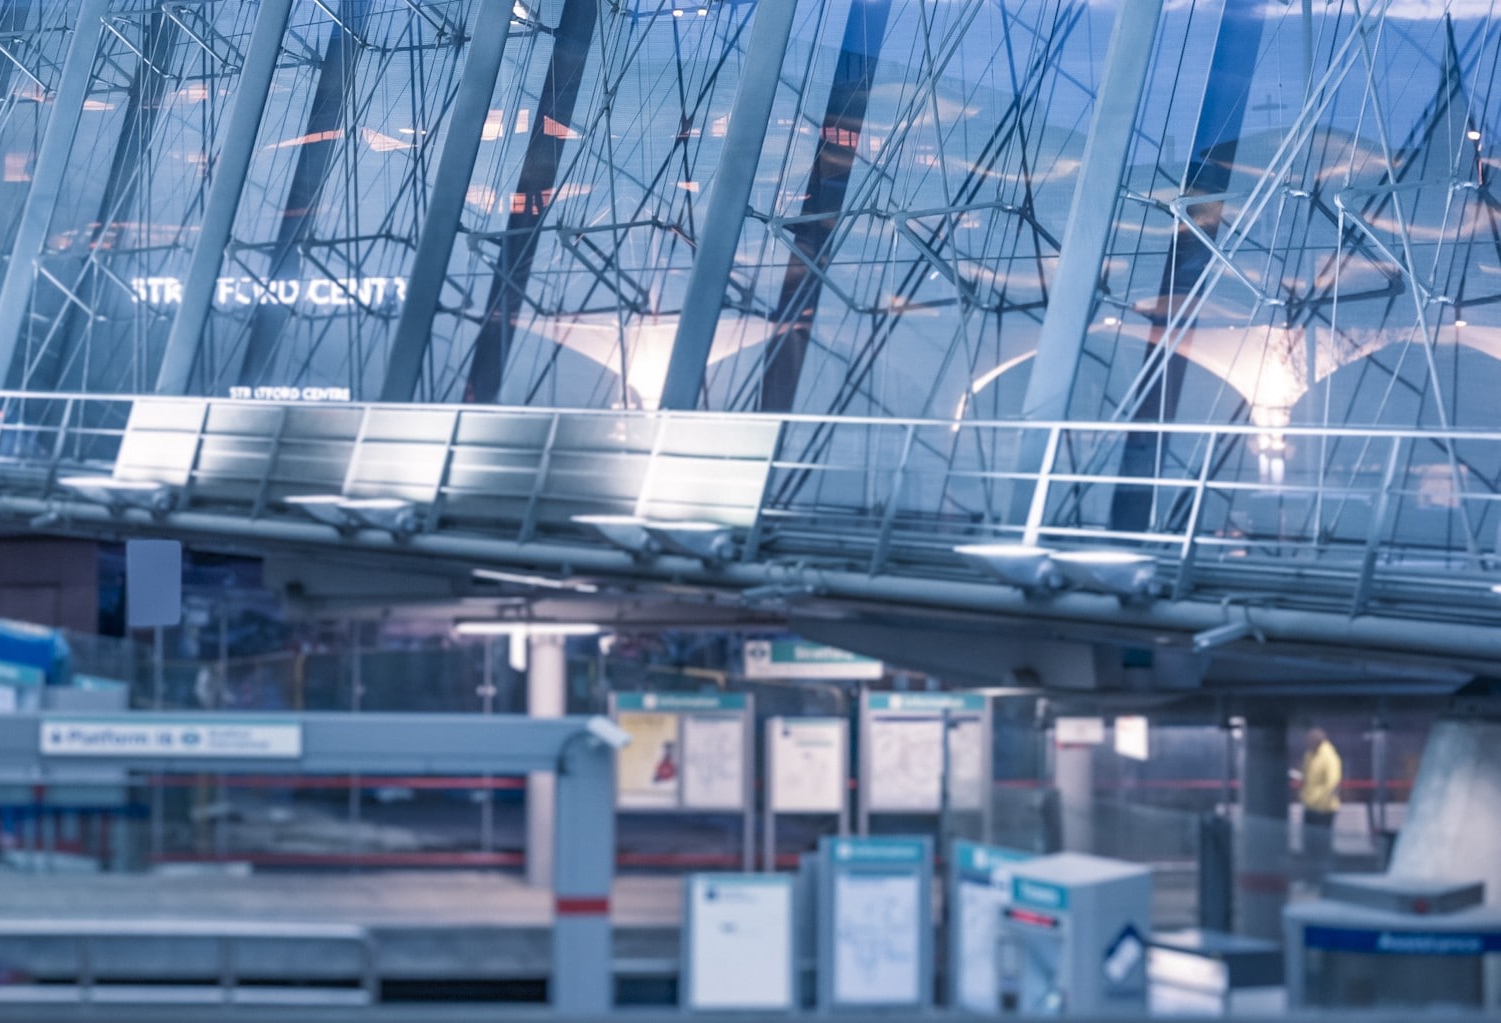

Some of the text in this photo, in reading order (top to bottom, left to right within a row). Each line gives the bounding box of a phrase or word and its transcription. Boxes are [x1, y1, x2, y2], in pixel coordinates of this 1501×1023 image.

[131, 277, 406, 304] STRFORD CENTR
[302, 387, 350, 401] CENTRE
[68, 729, 148, 745] Platform
